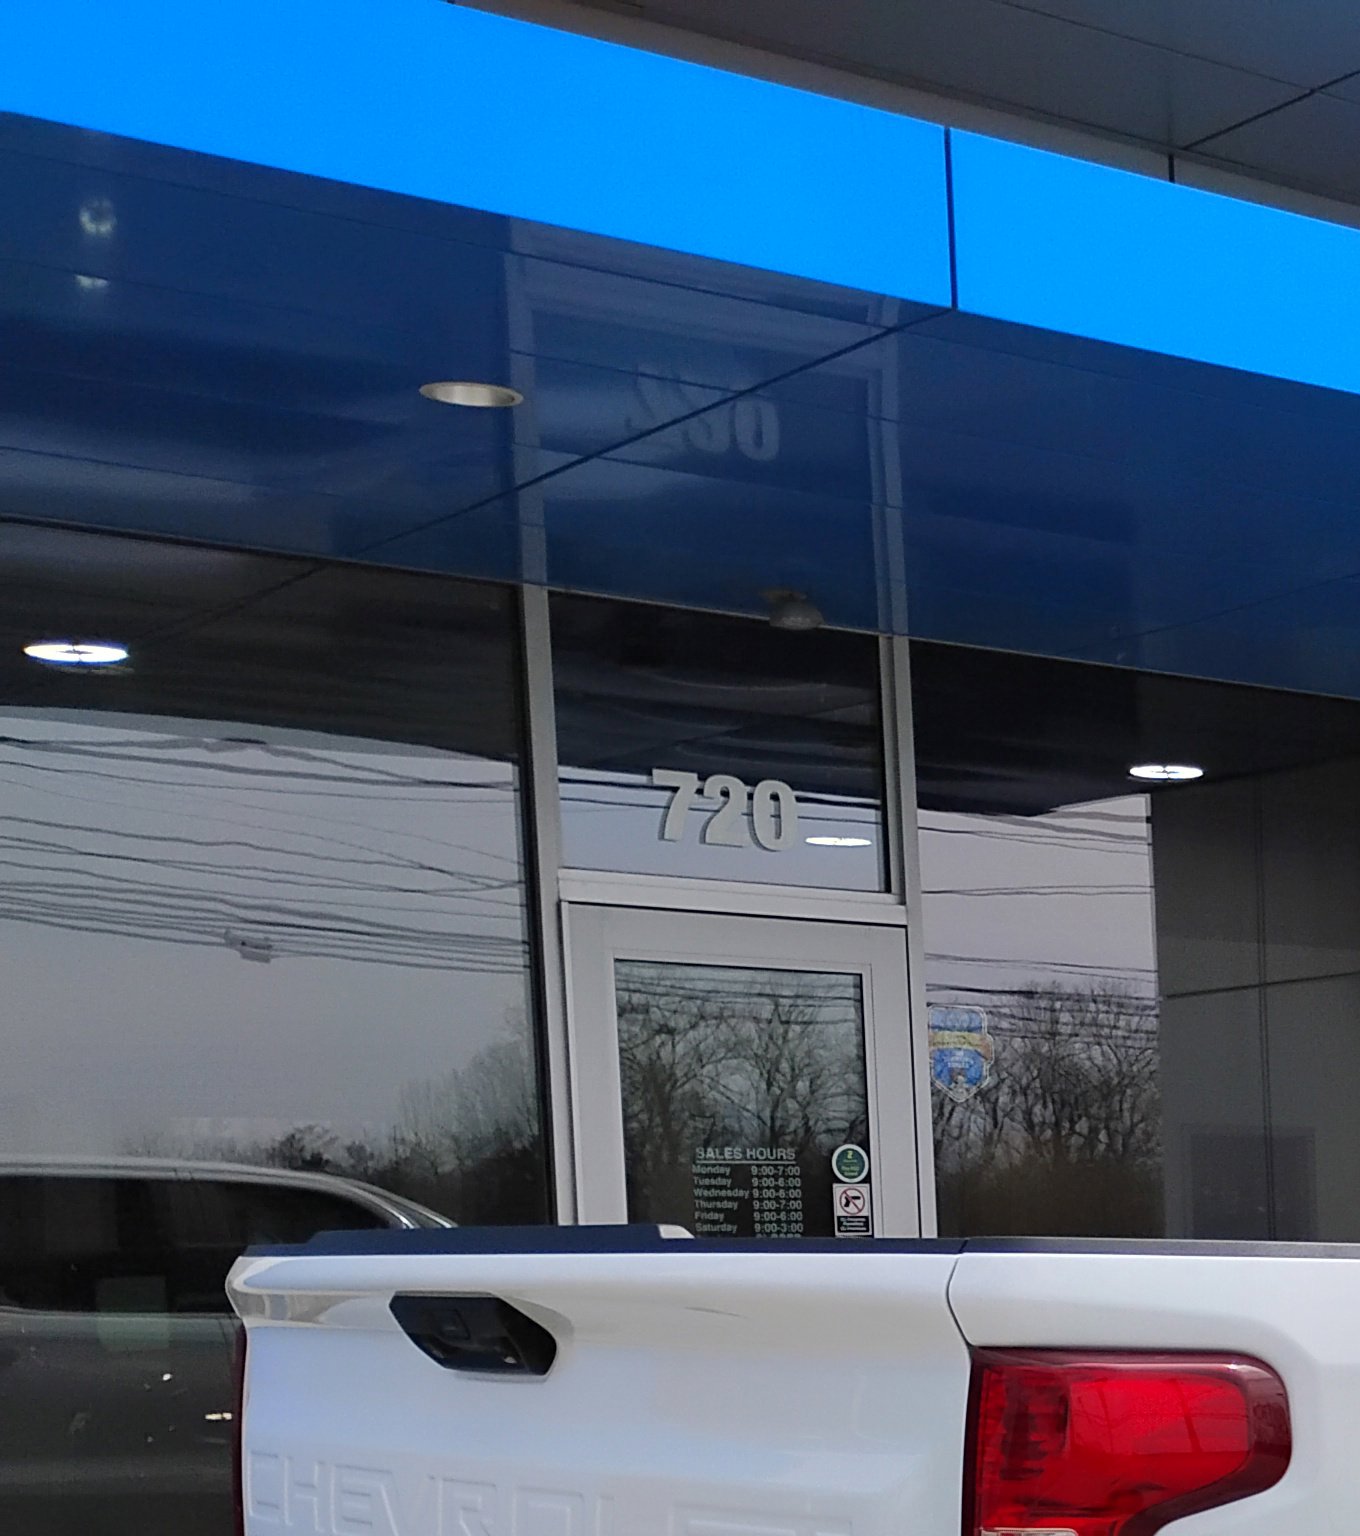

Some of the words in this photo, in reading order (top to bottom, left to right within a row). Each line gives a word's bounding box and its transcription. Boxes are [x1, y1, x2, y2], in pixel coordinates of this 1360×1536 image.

[651, 768, 798, 852] 720
[696, 1147, 743, 1160] SALES
[747, 1148, 796, 1160] HOURS
[692, 1165, 731, 1175] Monday
[751, 1165, 801, 1176] 9:00-7:00
[693, 1177, 732, 1188] Tuesday
[693, 1189, 750, 1199] Wednesday
[694, 1200, 738, 1210] Thursday
[753, 1200, 803, 1210] 9:00-7:00
[694, 1211, 725, 1222] Friday
[753, 1211, 804, 1222] 9:00-6:00
[696, 1223, 738, 1234] Saturday
[754, 1223, 804, 1233] 9:00-3:00
